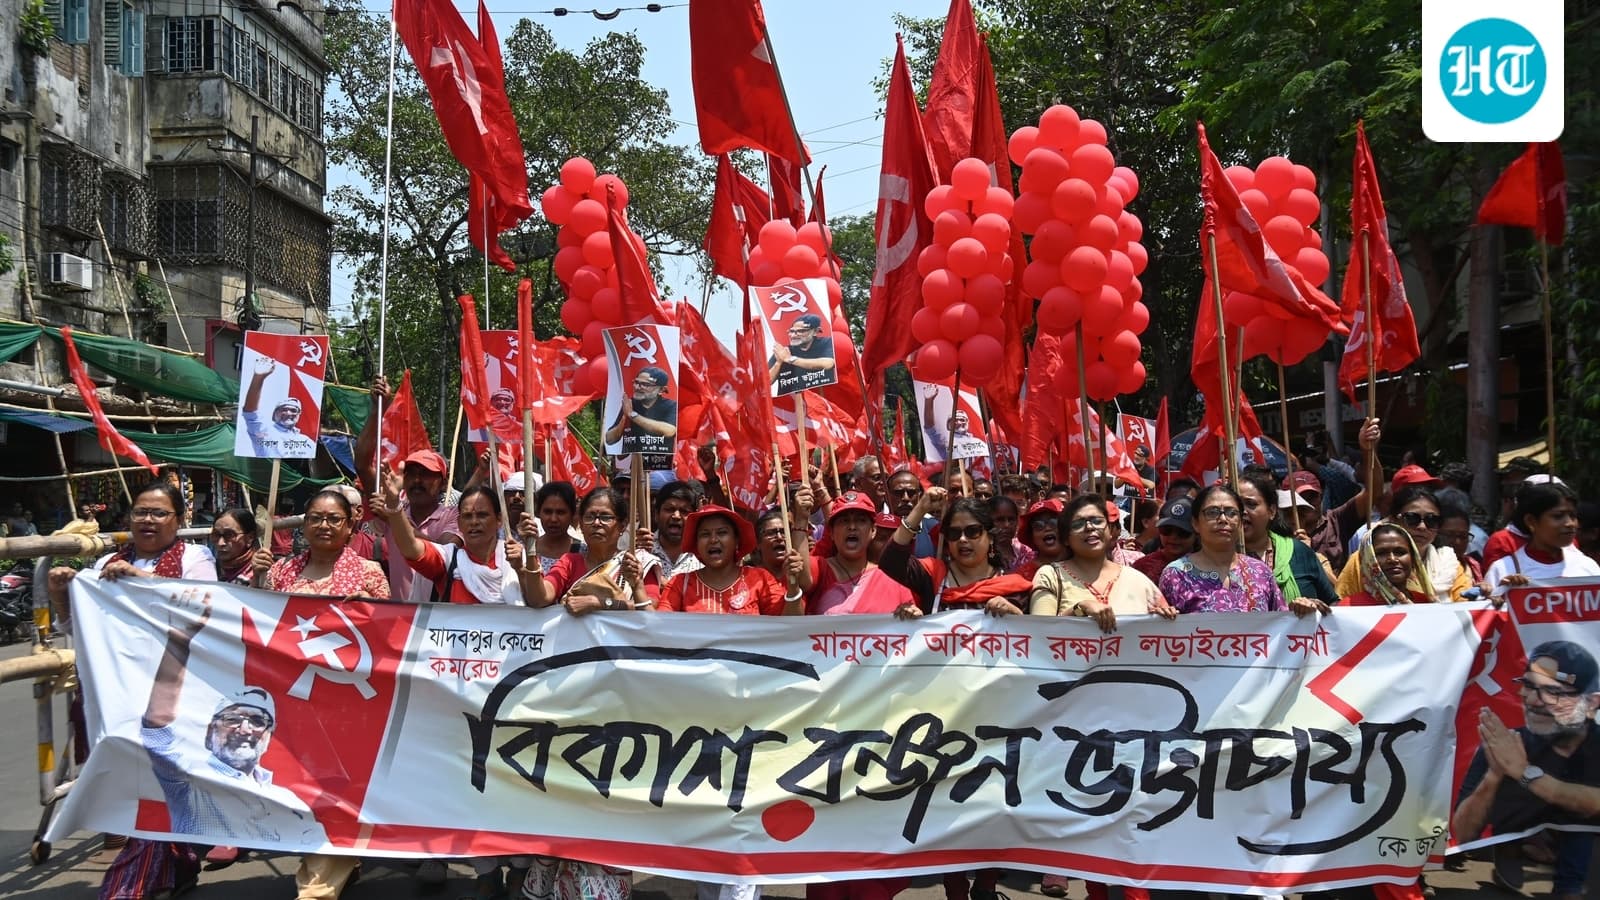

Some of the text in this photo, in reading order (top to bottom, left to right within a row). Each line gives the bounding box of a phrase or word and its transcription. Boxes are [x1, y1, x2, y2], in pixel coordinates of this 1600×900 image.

[428, 627, 546, 655] যাদবপুর কেন্দ্রে
[809, 631, 909, 665] মানুষের
[923, 623, 1031, 661] অধিকার
[1046, 635, 1123, 664] রক্ষার
[1139, 626, 1269, 663] লড়াইয়ের
[428, 656, 502, 682] কমরেড
[462, 645, 822, 814] বিকাশ
[762, 712, 1043, 844] রঞ্জন
[1376, 836, 1411, 859] কে
